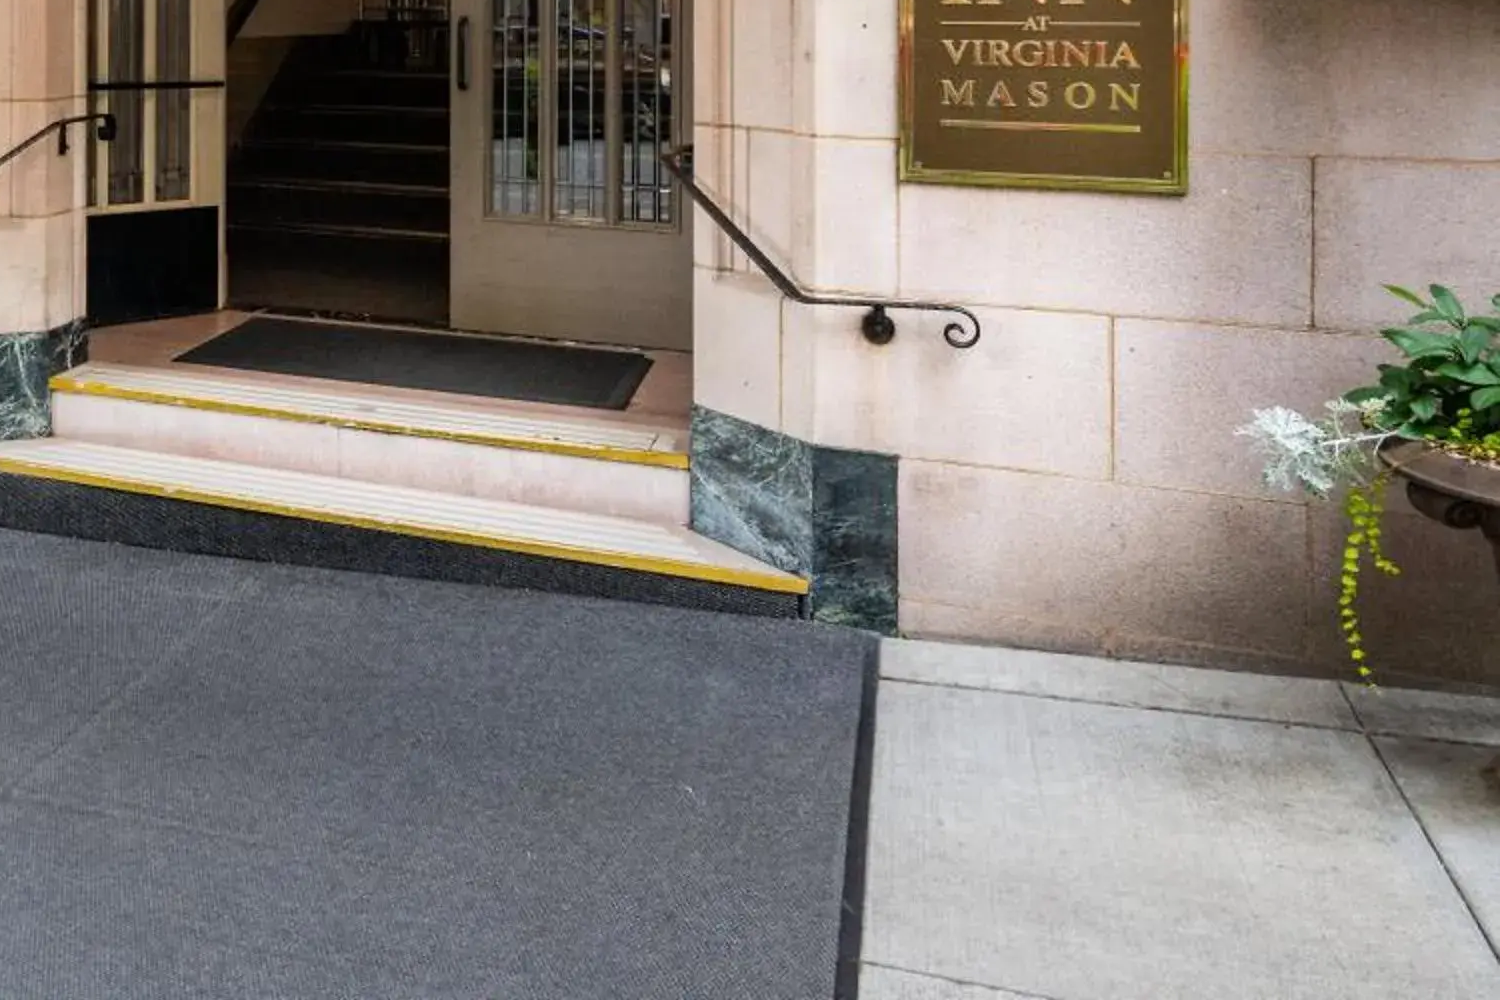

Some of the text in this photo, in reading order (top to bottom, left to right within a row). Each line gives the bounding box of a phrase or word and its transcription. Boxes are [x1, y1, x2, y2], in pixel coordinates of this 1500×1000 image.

[1022, 16, 1049, 31] AT
[942, 39, 1141, 68] VIRGINIA
[941, 79, 1141, 111] MASON
